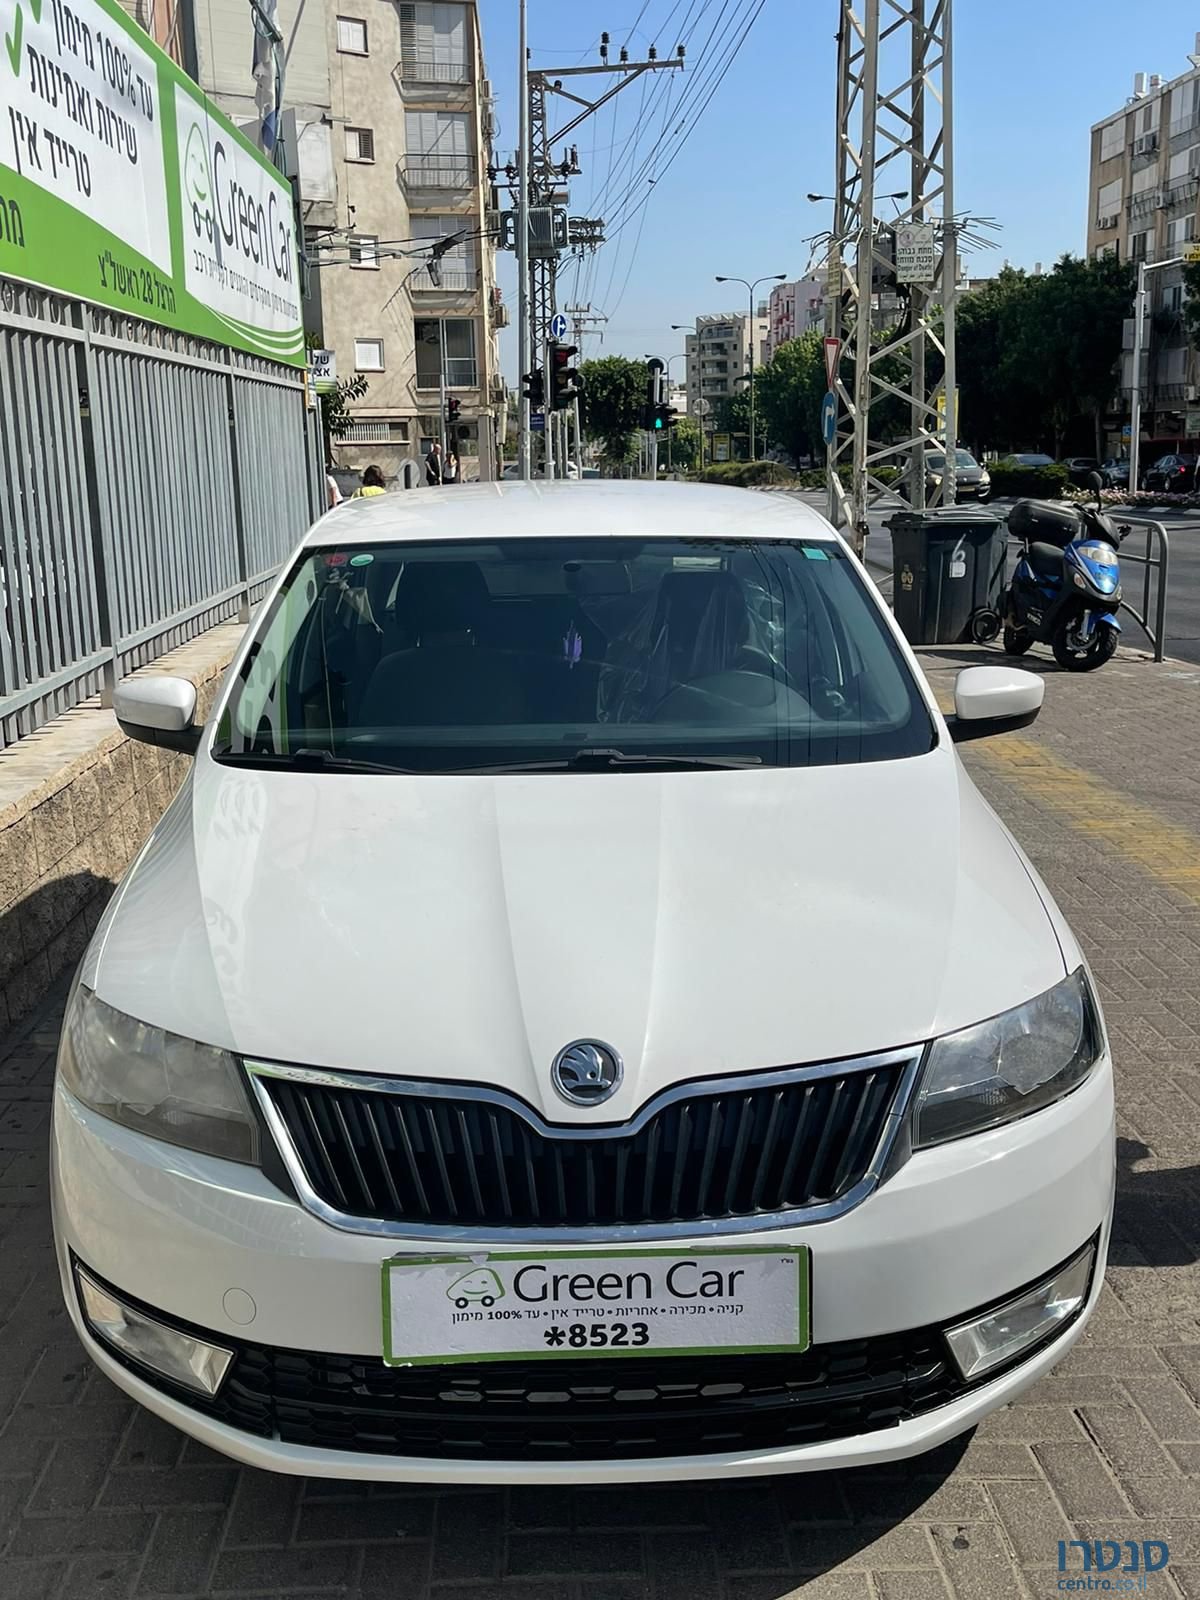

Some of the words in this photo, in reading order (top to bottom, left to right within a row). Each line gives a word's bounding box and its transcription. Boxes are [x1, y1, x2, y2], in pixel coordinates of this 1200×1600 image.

[52, 0, 95, 71] מימון
[27, 43, 95, 135] ואמינות
[96, 31, 136, 107] 100%
[136, 74, 154, 122] עד
[8, 105, 42, 175] אין
[95, 97, 138, 165] שירות
[43, 128, 91, 198] טרייד
[213, 141, 270, 270] Green
[268, 191, 293, 285] Car
[140, 267, 153, 305] 28
[153, 271, 176, 313] הרצל
[513, 1264, 652, 1302] Green
[666, 1261, 745, 1298] Car
[452, 1312, 483, 1325] מימון
[487, 1310, 522, 1320] 100%
[525, 1310, 540, 1319] עד
[551, 1308, 569, 1321] אין
[572, 1307, 605, 1318] טרייד
[615, 1306, 659, 1317] אחריות
[669, 1305, 706, 1316] מכירה
[716, 1303, 744, 1316] קניה
